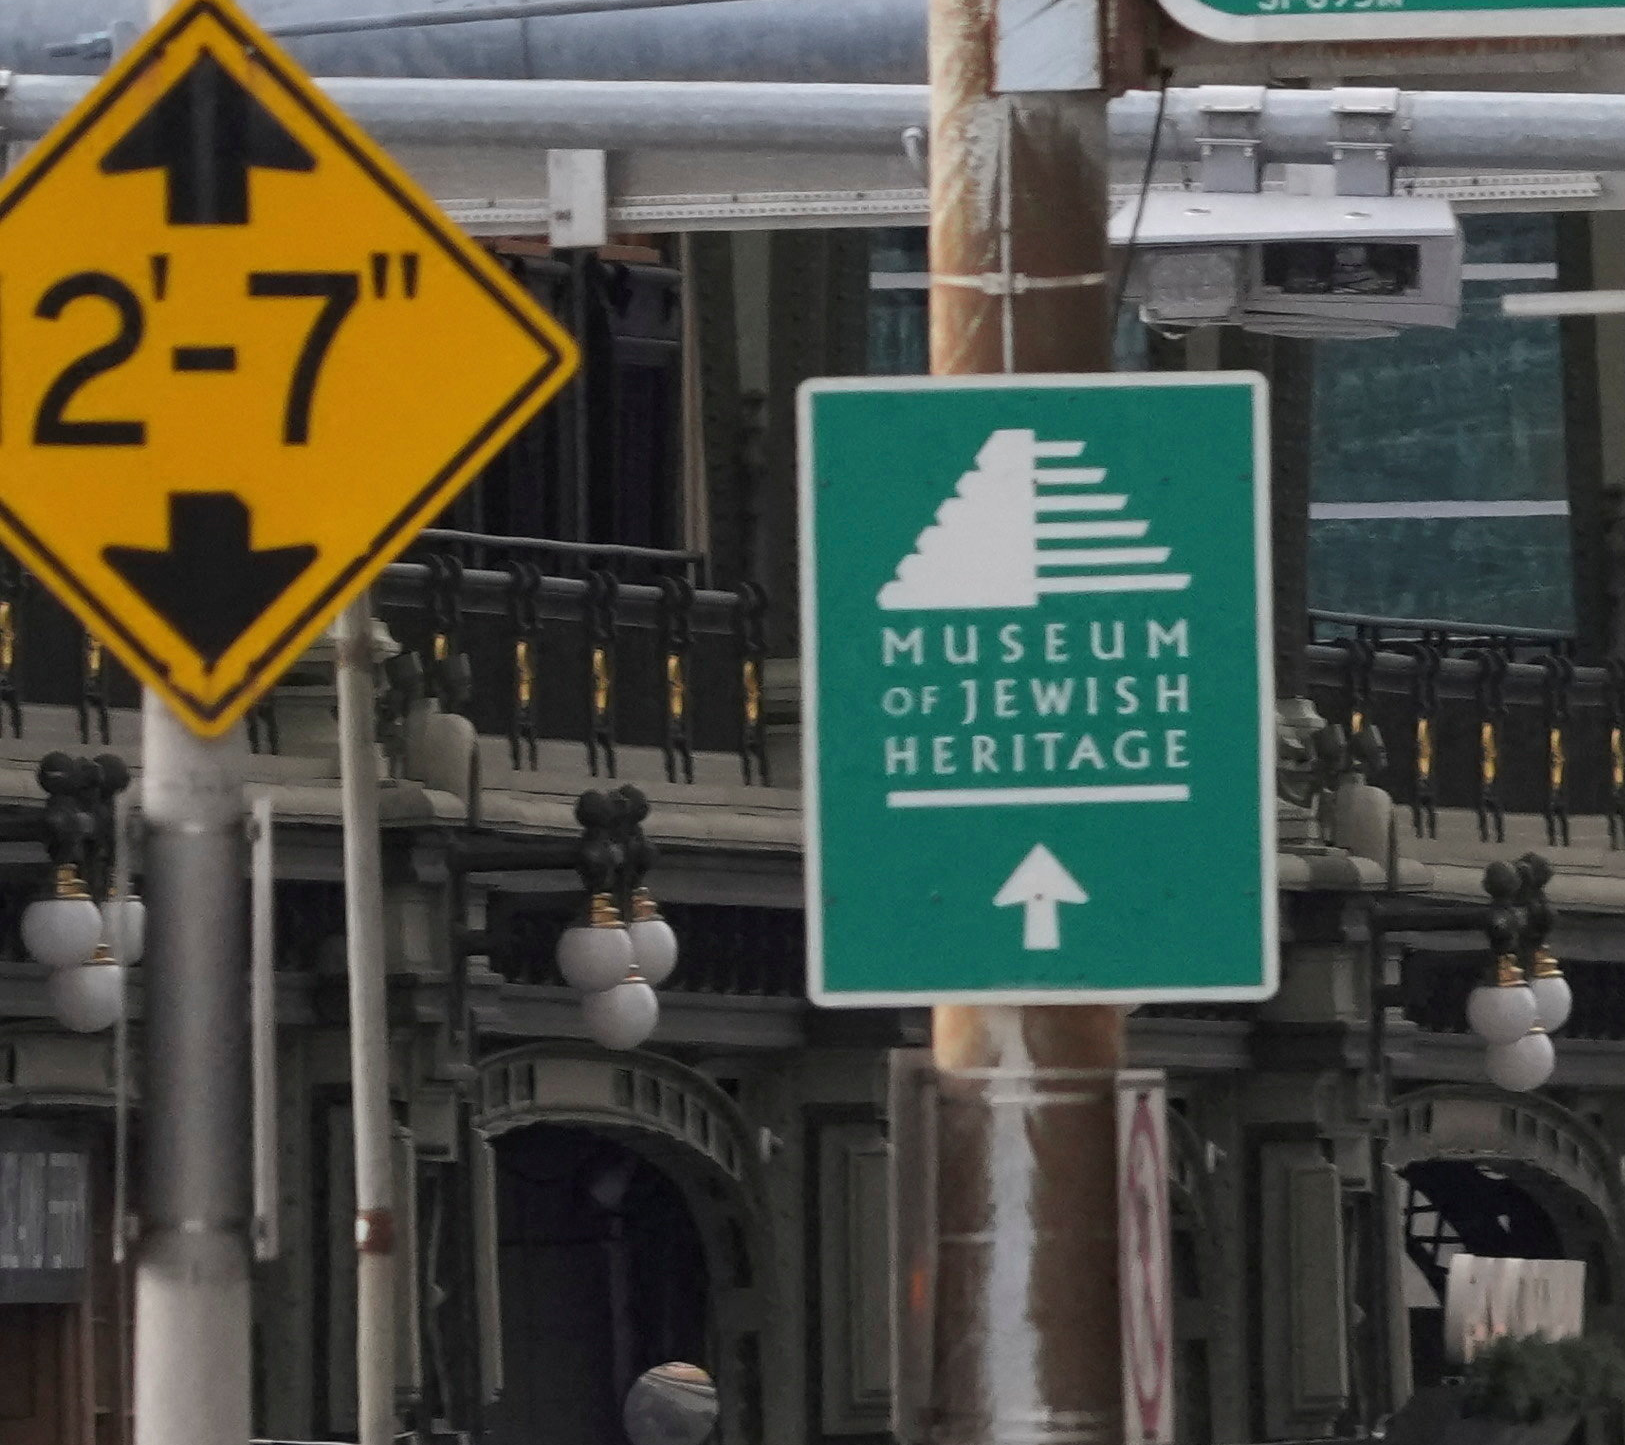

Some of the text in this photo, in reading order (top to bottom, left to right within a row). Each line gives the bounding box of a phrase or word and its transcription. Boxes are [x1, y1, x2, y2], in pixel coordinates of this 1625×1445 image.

[0, 253, 418, 447] 2'-7"
[882, 618, 1189, 667] MUSEUM
[881, 673, 1189, 725] OF JEWISH
[885, 730, 1190, 776] HERITAGE
